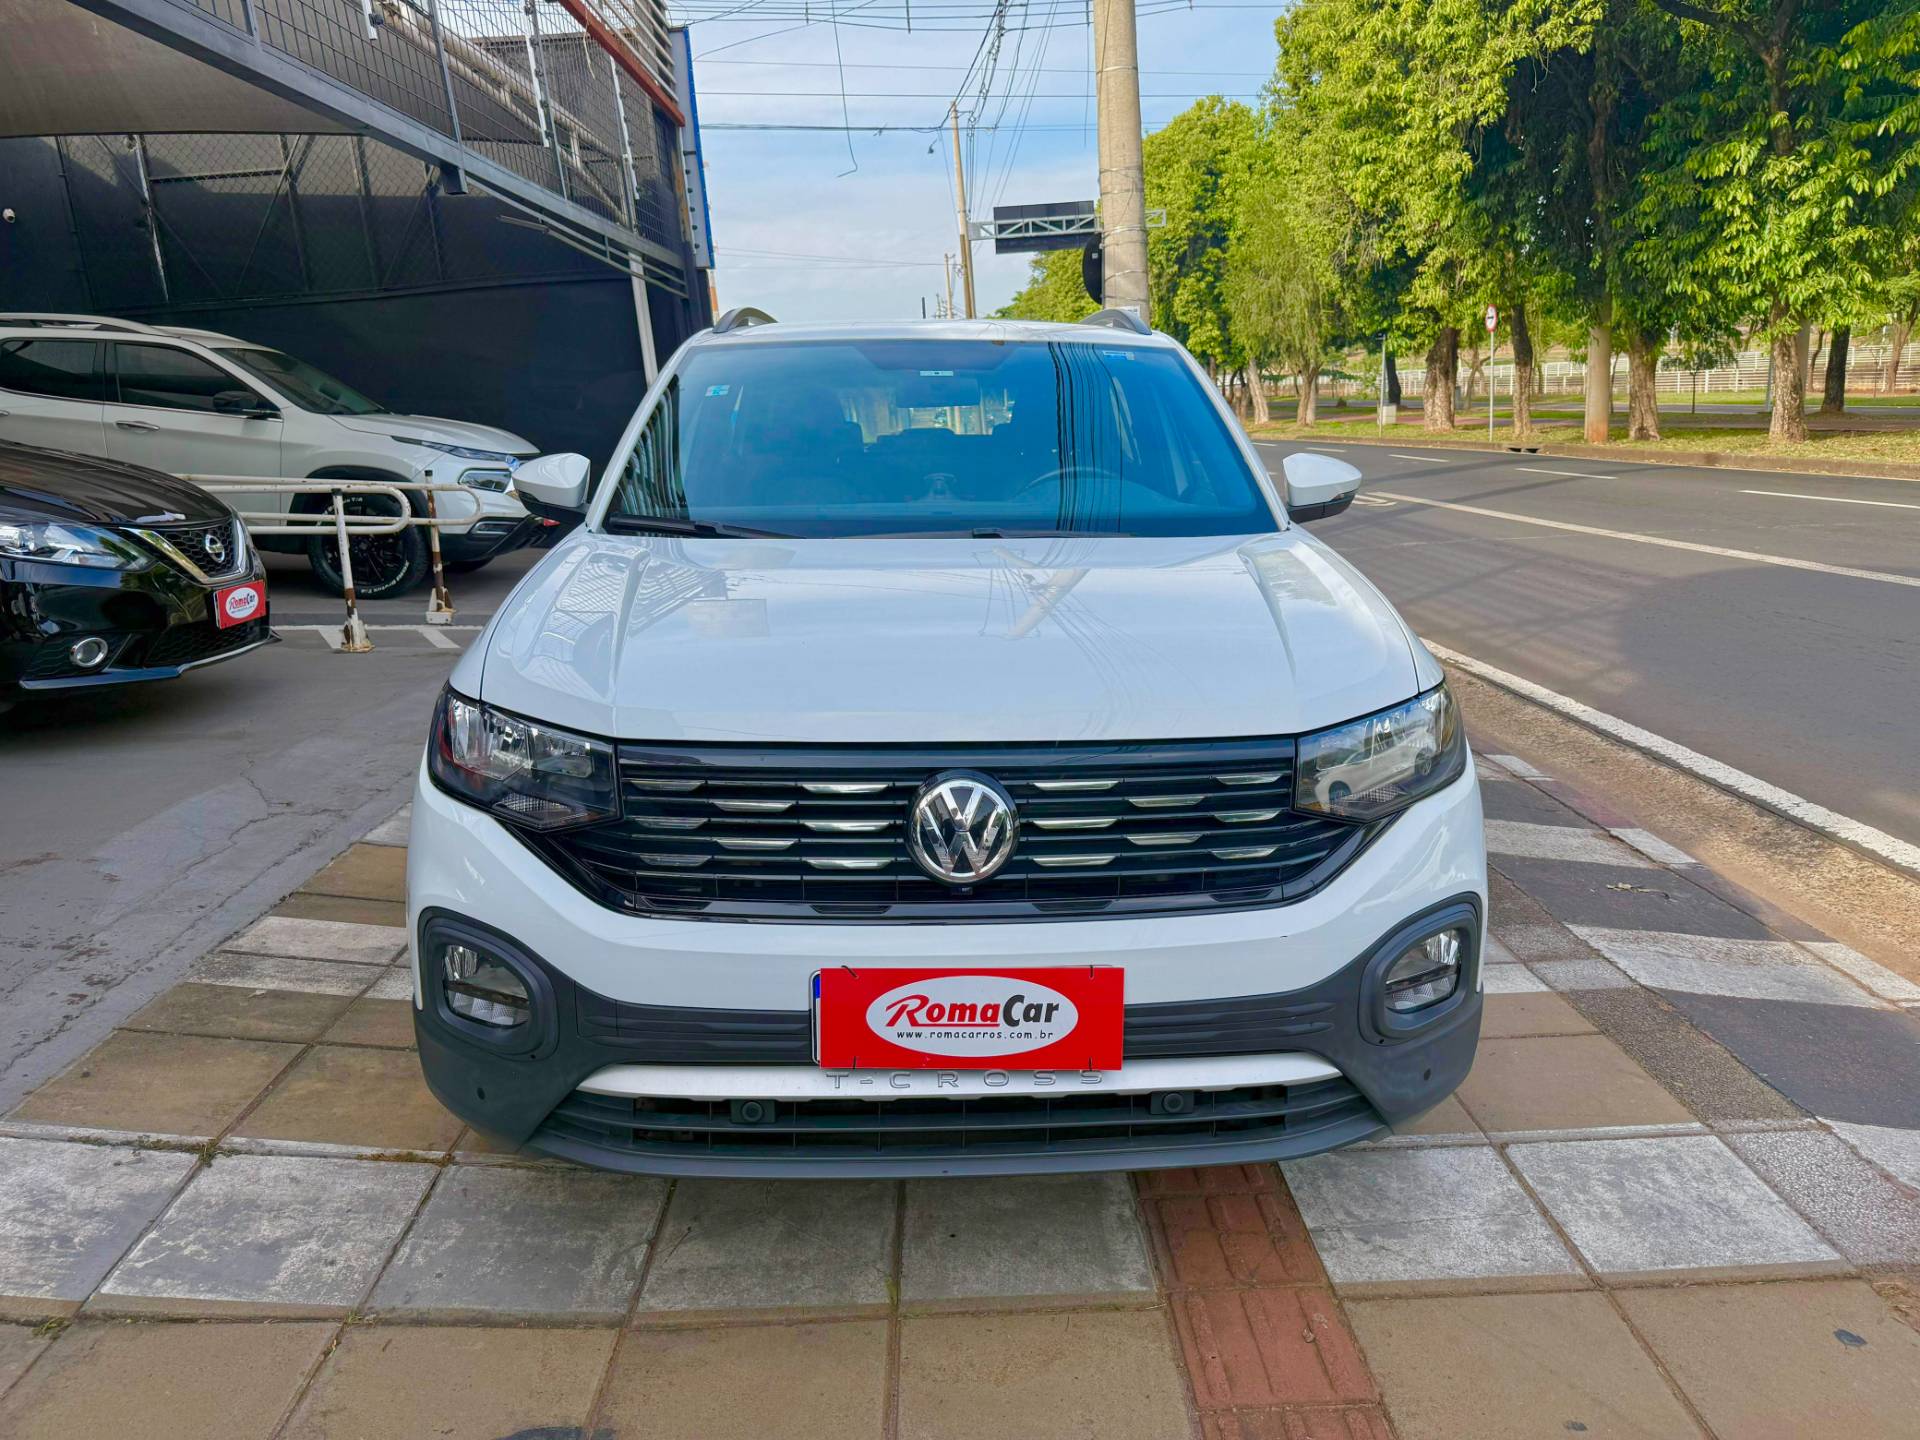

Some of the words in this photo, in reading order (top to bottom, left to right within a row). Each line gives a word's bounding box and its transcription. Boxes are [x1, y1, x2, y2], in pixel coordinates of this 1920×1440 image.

[885, 994, 1060, 1028] RomaCar
[896, 1029, 1054, 1040] www.romacarros.com.br
[825, 1070, 1103, 1090] T-CROSS
